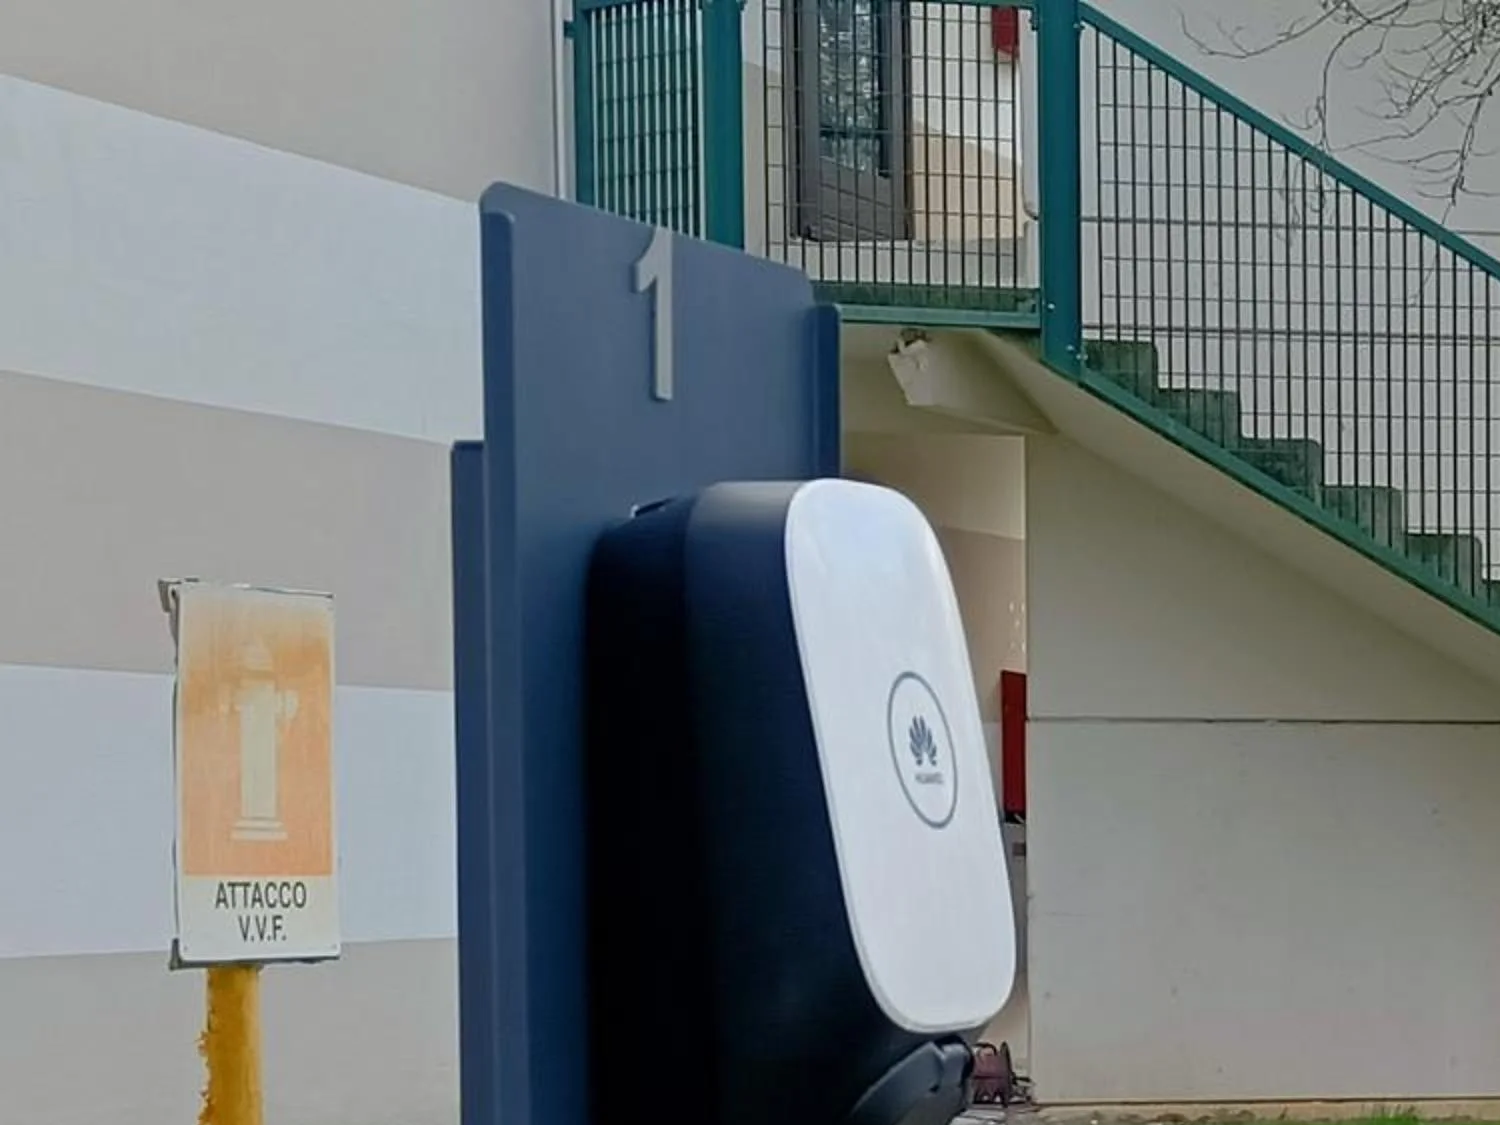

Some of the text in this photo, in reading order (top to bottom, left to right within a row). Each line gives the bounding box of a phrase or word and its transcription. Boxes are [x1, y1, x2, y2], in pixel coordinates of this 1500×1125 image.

[634, 225, 673, 400] 1
[215, 881, 307, 909] ATTACCO
[238, 915, 287, 942] V.V.F.
